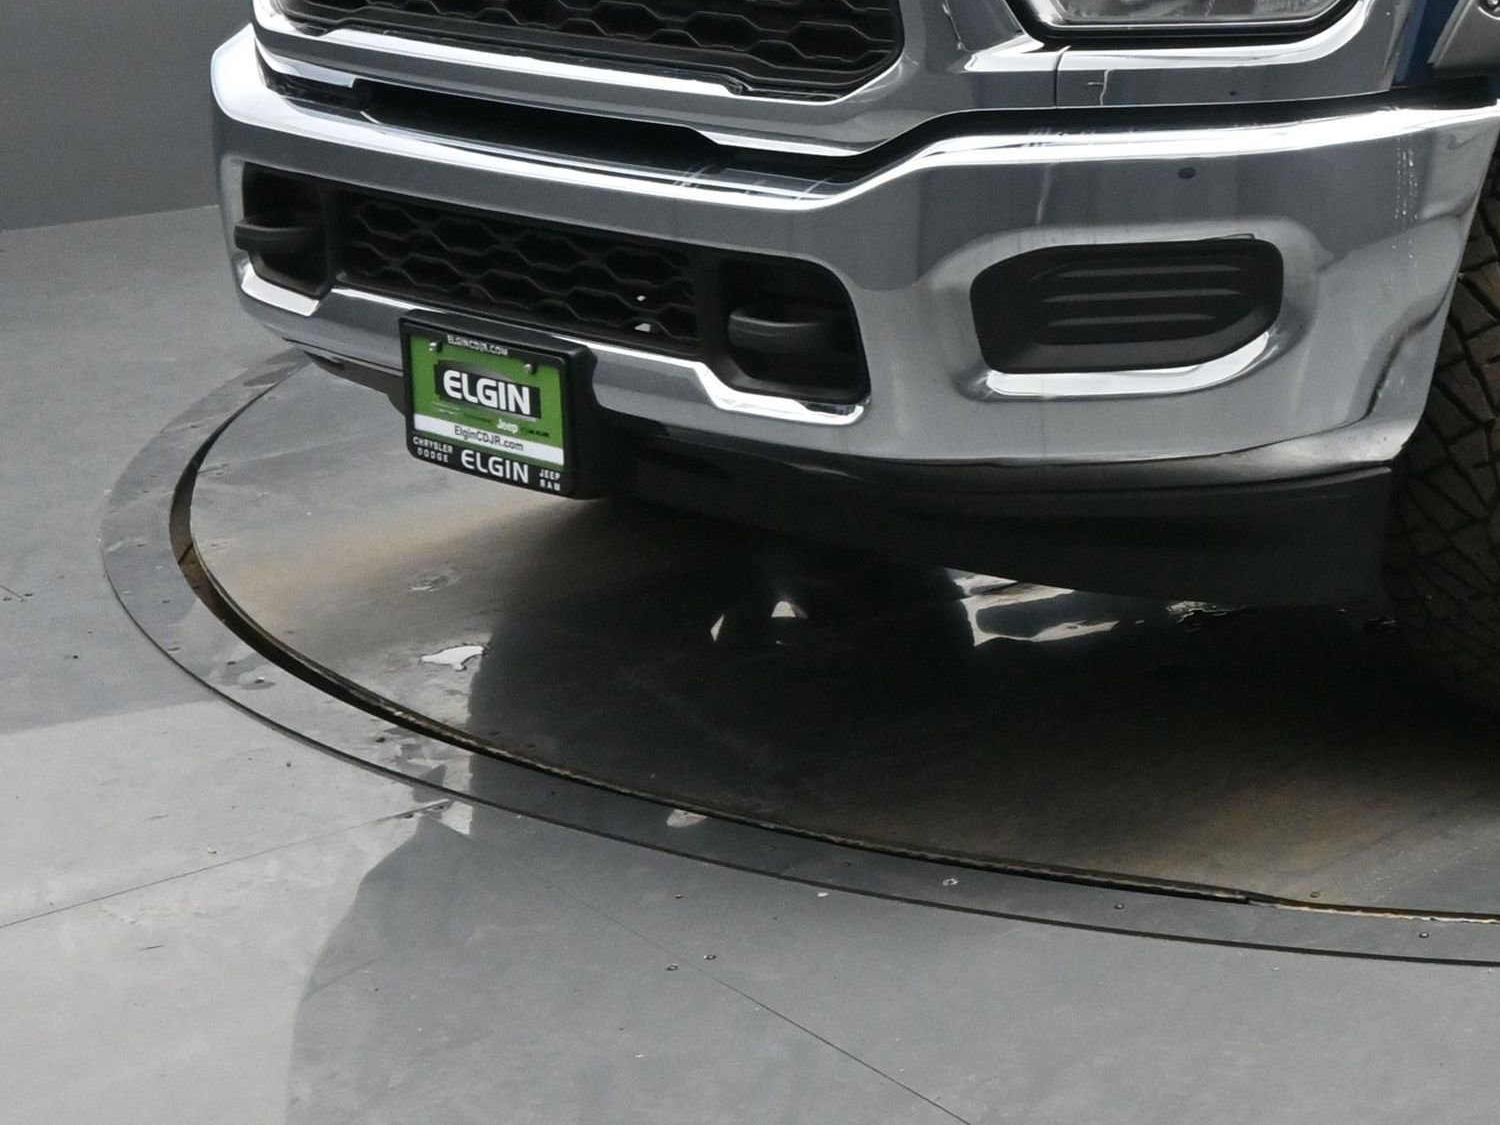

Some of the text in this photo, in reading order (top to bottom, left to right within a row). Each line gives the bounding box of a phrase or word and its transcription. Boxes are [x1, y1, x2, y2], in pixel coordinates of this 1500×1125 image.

[443, 369, 531, 415] ELGIN
[412, 436, 453, 454] CHRYSLER
[454, 425, 524, 452] ElginCDJR.com
[417, 446, 449, 463] DODGE
[460, 449, 530, 484] ELGIN
[538, 468, 561, 480] JEEP
[538, 478, 561, 492] RAM
